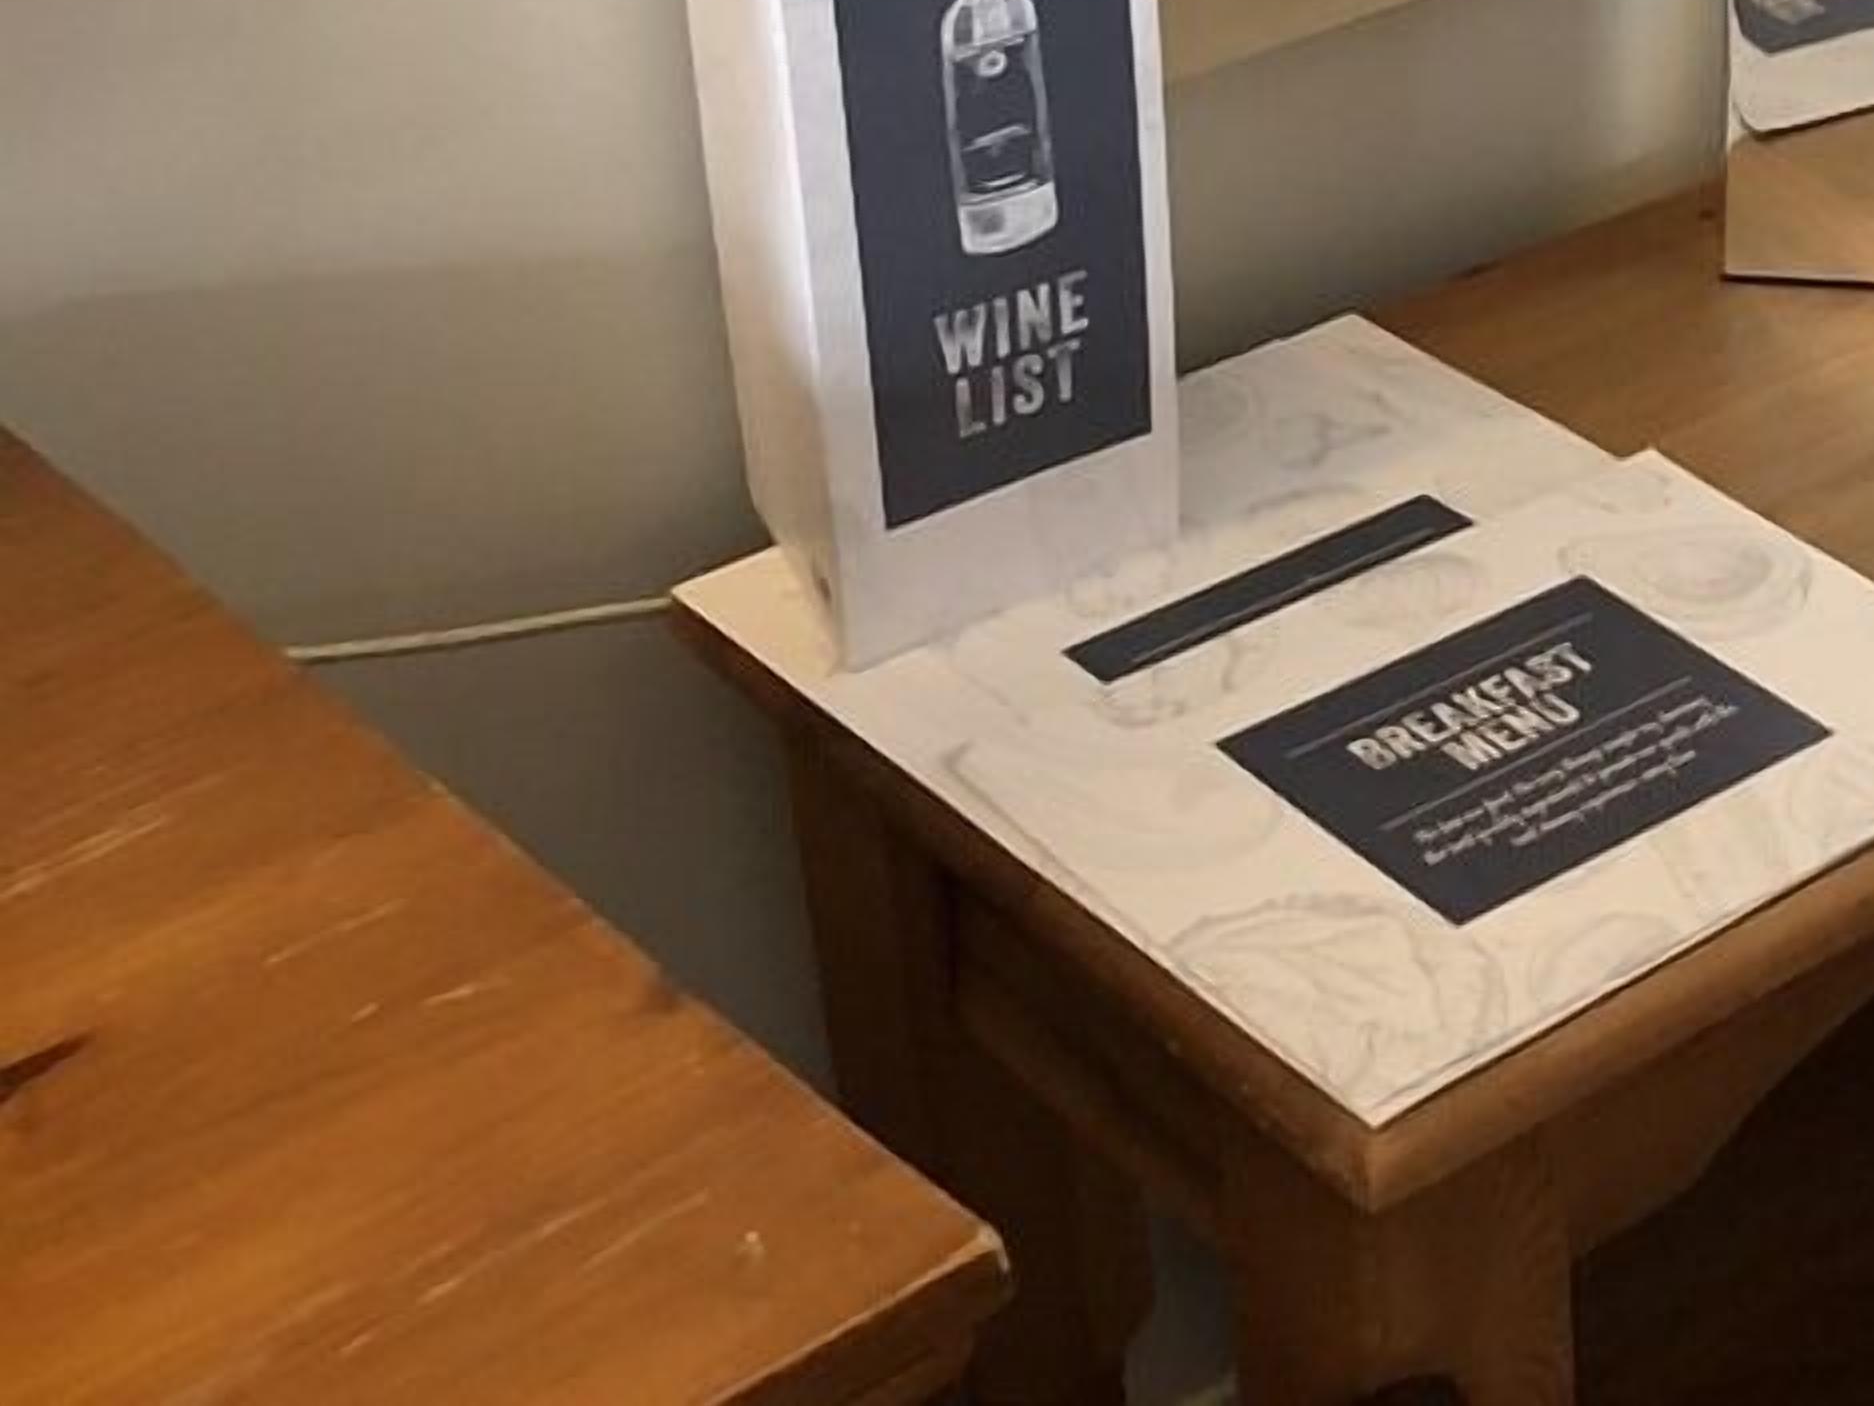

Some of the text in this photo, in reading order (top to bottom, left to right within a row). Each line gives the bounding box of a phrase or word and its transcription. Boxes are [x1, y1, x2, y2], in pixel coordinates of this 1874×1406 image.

[933, 269, 1088, 374] WINE
[955, 339, 1081, 438] LIST
[1346, 642, 1593, 771] BREAKFAST
[1444, 693, 1580, 770] MENU
